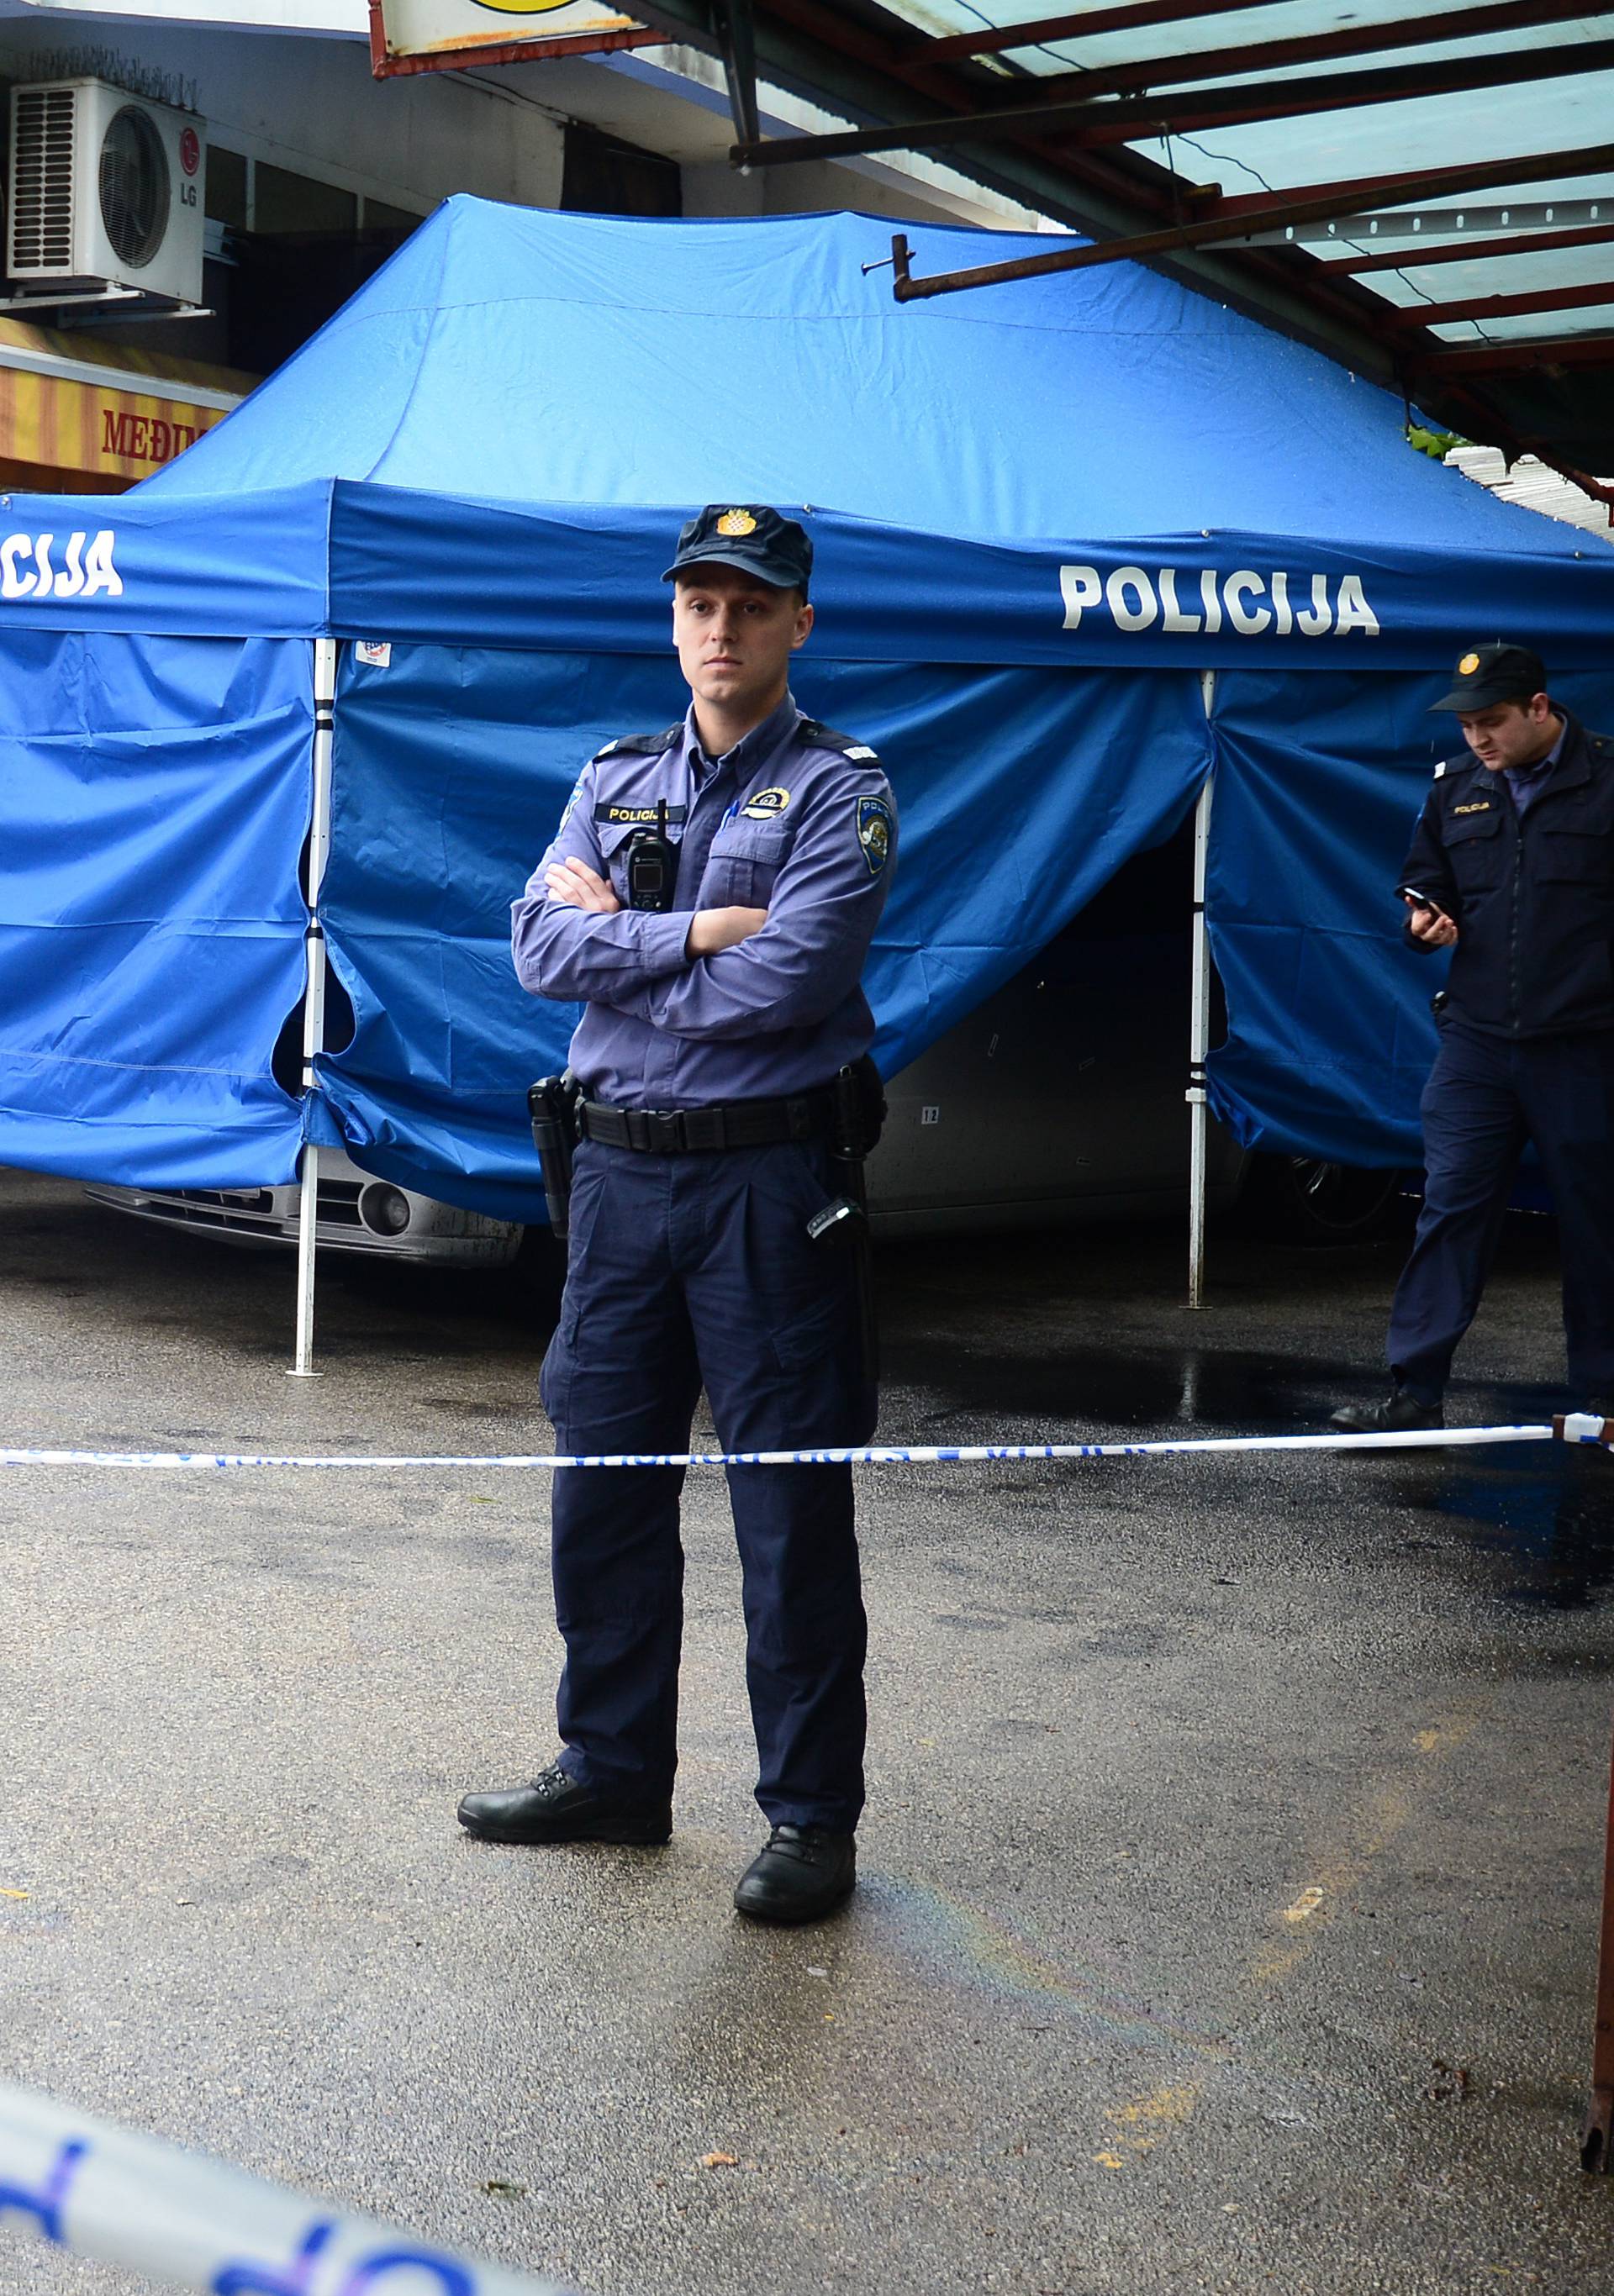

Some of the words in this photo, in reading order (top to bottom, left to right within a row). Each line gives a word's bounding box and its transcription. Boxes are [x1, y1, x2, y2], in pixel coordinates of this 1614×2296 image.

[181, 182, 197, 207] LG
[0, 529, 124, 598] CIJA
[1059, 565, 1379, 636] POLICIJA
